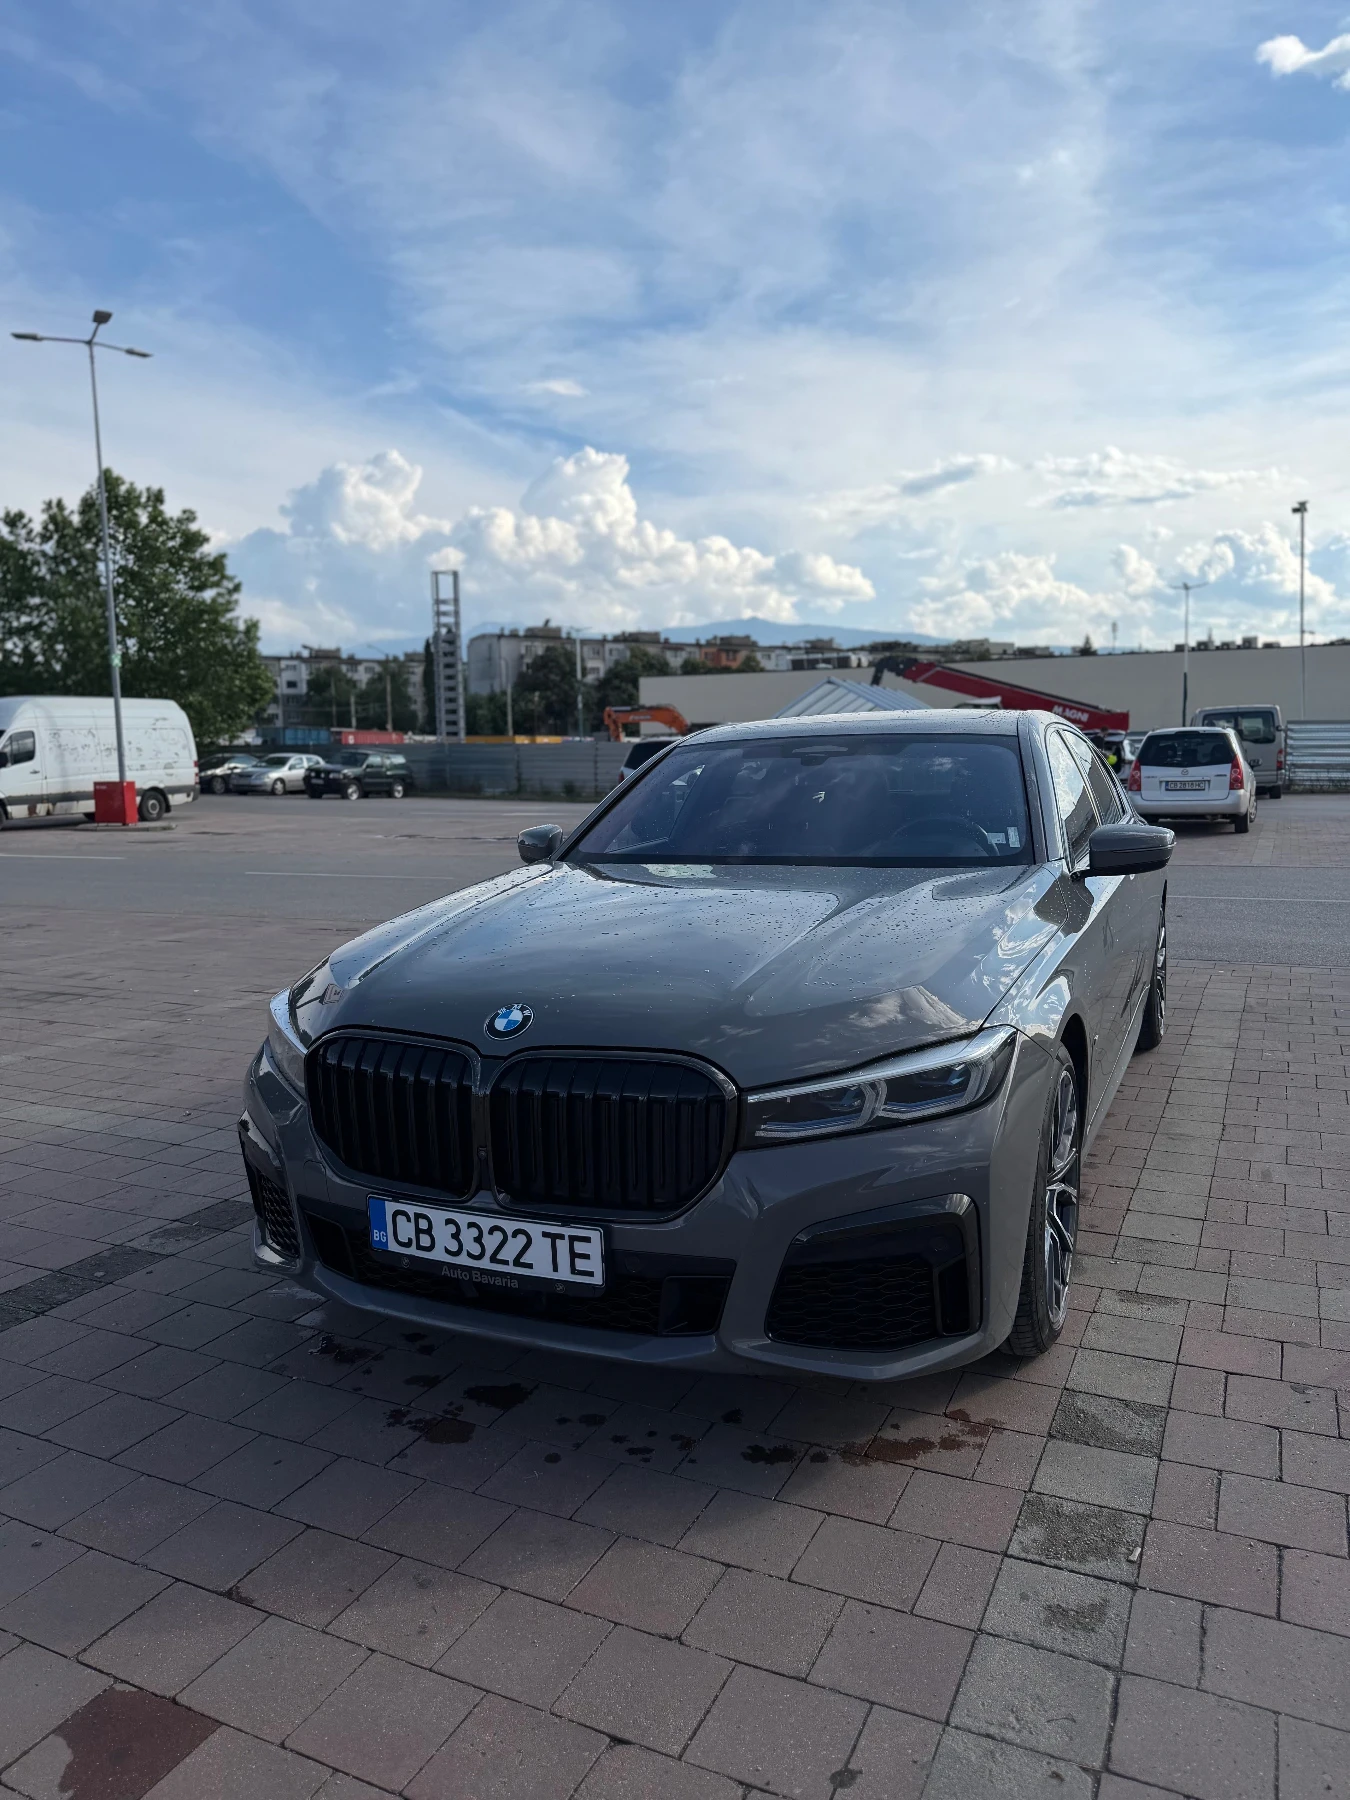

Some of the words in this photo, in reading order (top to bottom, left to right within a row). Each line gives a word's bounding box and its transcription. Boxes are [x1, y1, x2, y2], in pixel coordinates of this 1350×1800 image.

[1052, 704, 1089, 722] MAGNI
[373, 1230, 387, 1242] BG
[391, 1209, 436, 1252] CB
[444, 1218, 534, 1269] 3322
[541, 1231, 595, 1277] TE
[441, 1265, 470, 1281] Auto
[471, 1271, 519, 1289] Bavaria
